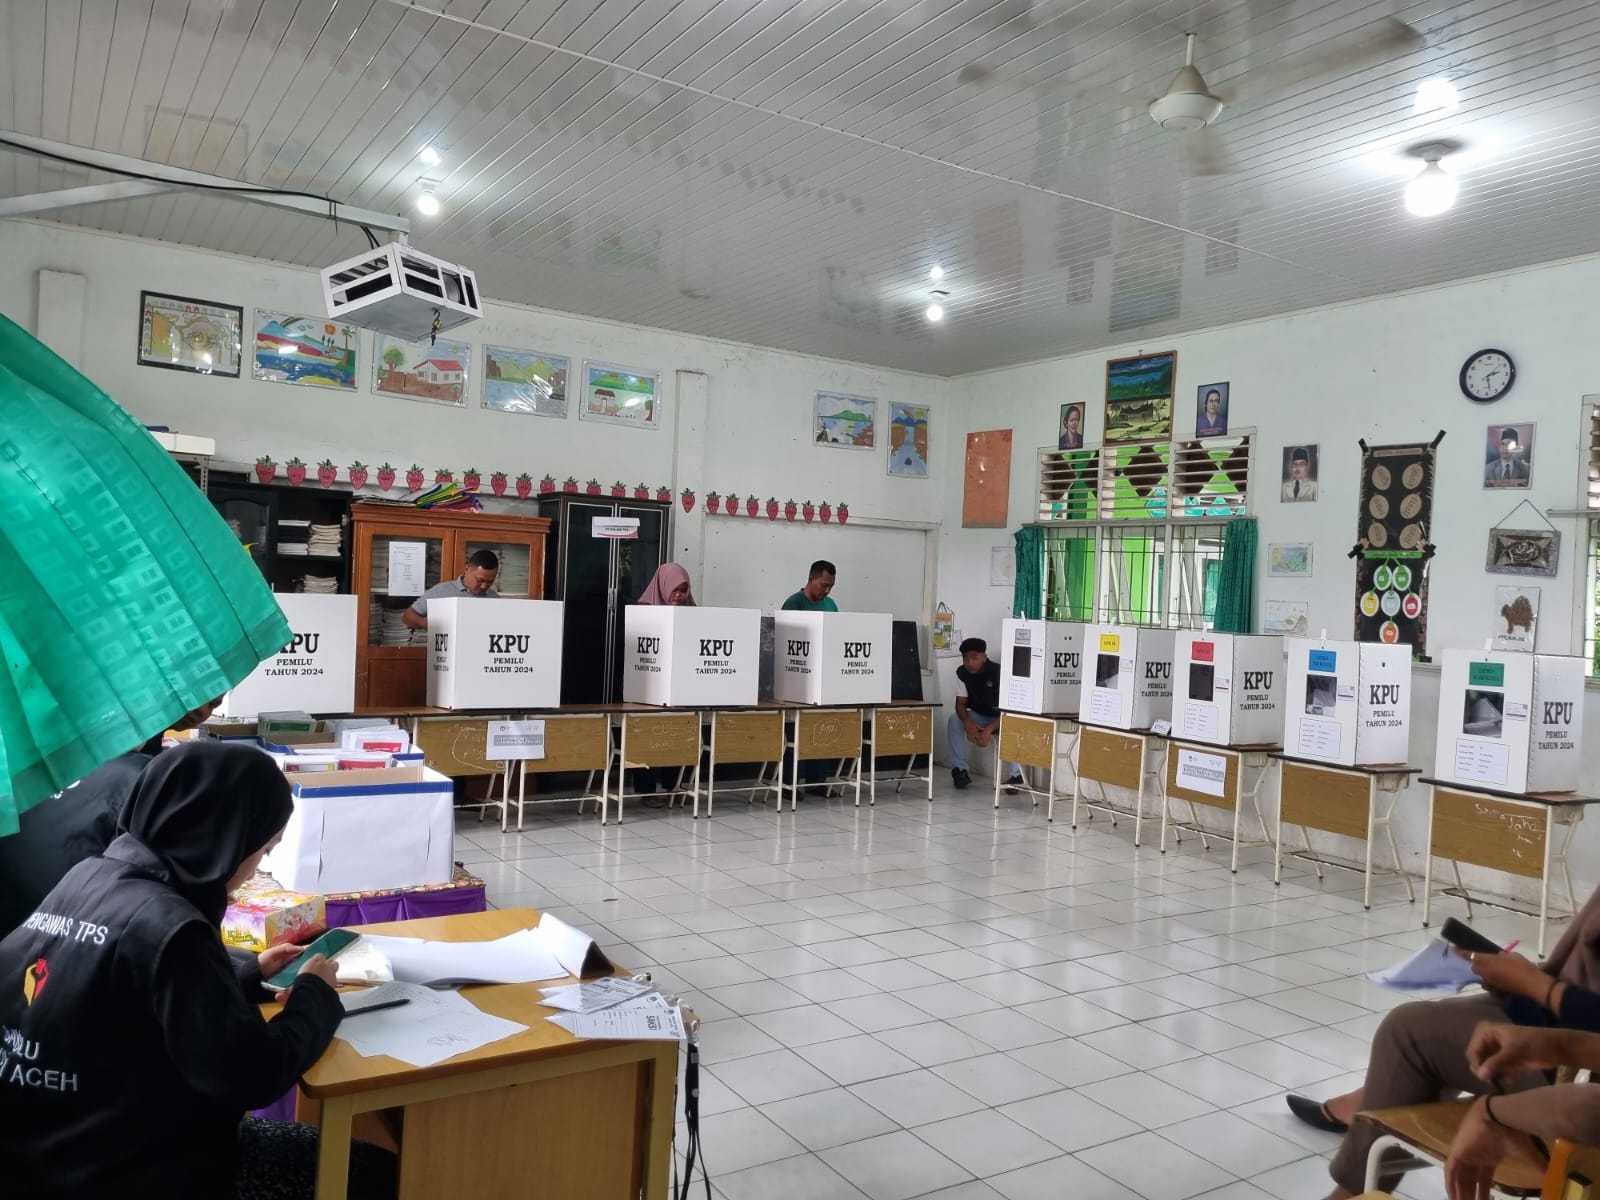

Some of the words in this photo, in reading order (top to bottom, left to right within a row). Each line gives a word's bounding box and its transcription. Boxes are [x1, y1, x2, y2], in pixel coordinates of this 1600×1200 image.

[435, 633, 449, 653] KPU
[488, 634, 530, 654] KPU
[637, 636, 660, 655] KPU
[699, 639, 734, 657] KPU
[787, 640, 810, 657] KPU
[844, 642, 872, 658] KPU
[276, 658, 313, 666] PEMILU
[493, 657, 525, 665] PEMILU
[1053, 652, 1080, 668] KPU
[300, 668, 324, 676] 2024
[1145, 662, 1172, 679] KPU
[1243, 671, 1273, 690] KPU
[1369, 684, 1400, 705] KPU
[1542, 701, 1573, 725] KPU
[1365, 720, 1387, 728] TAHUN
[1388, 719, 1403, 727] 2024
[1545, 730, 1568, 739] PEMILU
[1538, 742, 1558, 750] TAHUN
[1559, 742, 1574, 750] 2024
[75, 920, 109, 945] TPS
[9, 1063, 78, 1092] ACEH
